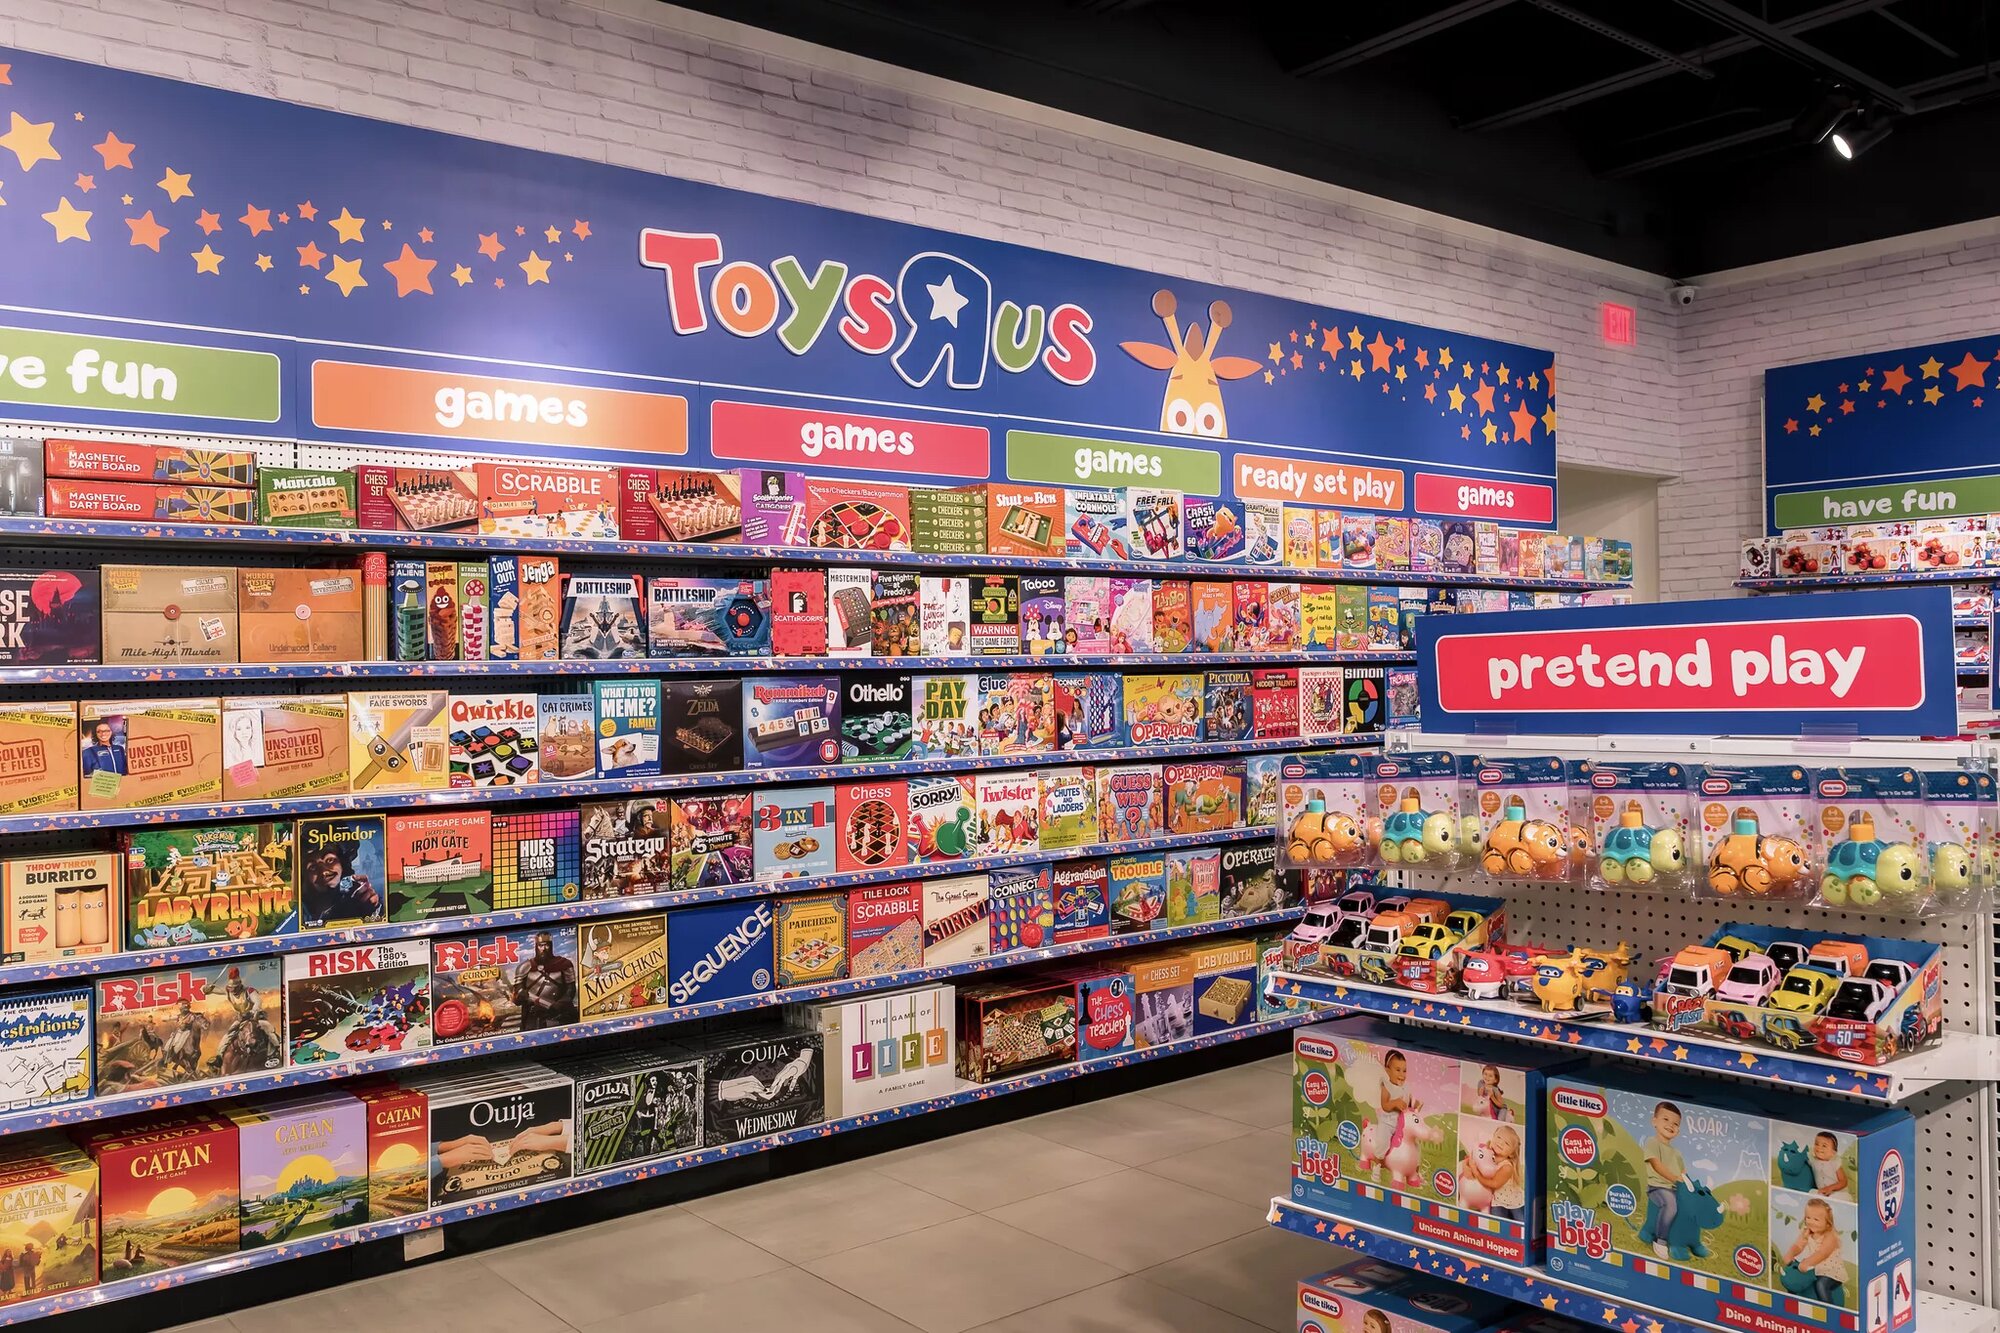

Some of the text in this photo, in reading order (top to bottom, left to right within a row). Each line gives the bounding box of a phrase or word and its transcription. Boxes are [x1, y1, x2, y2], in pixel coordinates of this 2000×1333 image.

[66, 349, 178, 402] fun
[435, 386, 589, 428] games
[800, 421, 914, 457] games
[68, 452, 126, 463] MAGNETIC
[1074, 448, 1162, 479] games
[69, 460, 141, 472] DART BOARD
[272, 476, 338, 490] Mancala
[364, 474, 388, 486] CHESS
[501, 472, 601, 495] SCRABBLE
[627, 478, 651, 491] CHESS
[1241, 463, 1396, 506] ready set play
[69, 492, 127, 502] MAGNETIC
[370, 485, 384, 497] SET
[633, 491, 646, 503] SET
[809, 485, 904, 498] Chess/Checkers/Backgammon
[937, 493, 964, 504] CHECKERS
[1075, 491, 1116, 503] INFLATABLE
[1457, 485, 1514, 511] games
[69, 501, 141, 512] DART BOARD
[995, 493, 1024, 507] Shut
[1033, 491, 1057, 504] Box
[1136, 495, 1175, 507] FREE FALL
[1823, 489, 1956, 520] have fun
[938, 506, 964, 515] CHECKERS
[1076, 502, 1117, 515] CORNHOLE
[939, 518, 964, 528] CHECKERS
[939, 530, 965, 540] CHECKERS
[940, 542, 965, 553] CHECKERS
[365, 557, 385, 565] PICK
[365, 564, 376, 572] UP
[492, 559, 515, 574] LOOK
[396, 569, 425, 577] ALIENS
[496, 571, 516, 584] OUT!
[521, 560, 555, 584] Jenga
[830, 574, 870, 583] MASTERMIND
[878, 574, 914, 583] Five Nights
[245, 579, 275, 587] MYSTERY
[576, 582, 632, 595] BATTLESHIP
[1022, 578, 1056, 591] Taboo
[654, 588, 716, 603] BATTLESHIP
[774, 615, 824, 623] SCATTERGORIES
[973, 625, 1017, 636] WARNING
[972, 636, 1018, 647] THIS GAME FARTS!
[120, 647, 221, 658] Mile-High Murder
[1487, 634, 1866, 700] pretend play
[978, 676, 1007, 693] Clue
[1208, 672, 1250, 684] PICTOPIA
[601, 687, 656, 699] WHAT DO YOU
[850, 683, 905, 702] Othello
[925, 680, 966, 700] PAY
[369, 698, 428, 708] FAKE SWORDS
[542, 701, 593, 713] CAT CRIMES
[601, 699, 656, 718] MEME?
[925, 700, 966, 720] DAY
[451, 699, 536, 723] Qwirkle
[30, 714, 73, 724] EVIDENCE
[628, 717, 656, 729] FAMILY
[129, 740, 188, 759] UNSOLVED
[265, 735, 319, 752] UNSOLVED
[12, 758, 41, 771] FILES
[130, 752, 189, 770] CASE FILES
[1111, 774, 1151, 790] GUESS
[18, 791, 60, 805] EVIDENCE
[850, 787, 891, 800] Chess
[980, 785, 1036, 803] Twister
[1054, 788, 1081, 798] CHUTES
[1116, 790, 1148, 808] WHO
[1053, 802, 1084, 814] LADDERS
[407, 816, 486, 830] THE ESCAPE GAME
[759, 801, 827, 833] 3 IN 1
[308, 828, 376, 850] Splendor
[411, 836, 469, 855] IRON GATE
[520, 838, 555, 858] HUES
[585, 836, 666, 863] Stratego
[26, 860, 97, 872] THROW THROW
[530, 855, 555, 869] CUES
[25, 869, 97, 886] BURRITO
[1053, 867, 1108, 886] Aggravation
[1111, 861, 1164, 880] TROUBLE
[863, 886, 910, 899] TILE LOCK
[137, 886, 293, 929] LABYRINTH
[857, 899, 919, 919] SCRABBLE
[789, 916, 838, 930] PARCHEESI
[378, 952, 407, 960] 1980's
[670, 901, 773, 1004] SEQUENCE
[1196, 947, 1252, 970] LABYRINTH
[309, 946, 394, 977] RISK The
[378, 959, 409, 969] Edition
[1150, 966, 1180, 980] CHESS SET
[100, 972, 209, 1014] Risk
[870, 1008, 932, 1026] THE GAME OF
[741, 1044, 788, 1065] OUIJA
[1300, 1043, 1333, 1057] little tikes
[584, 1080, 630, 1103] OUIJA
[885, 1084, 906, 1093] FAMILY
[908, 1079, 926, 1088] GAME
[1557, 1094, 1602, 1111] little tikes
[377, 1106, 422, 1125] CATAN
[470, 1096, 535, 1128] Ouija
[735, 1109, 798, 1139] WEDNESDAY
[1686, 1115, 1729, 1137] ROAR!
[130, 1143, 211, 1178] CATAN
[169, 1171, 188, 1179] GAME
[1882, 1164, 1900, 1179] PARENT
[476, 1179, 529, 1196] MYSTIFYING ORACLE
[1881, 1175, 1900, 1191] TRUSTED
[1553, 1201, 1594, 1224] play
[1418, 1221, 1519, 1257] Unicorn Animal Hopper
[1560, 1217, 1610, 1258] big!
[1304, 1294, 1338, 1312] little tikes
